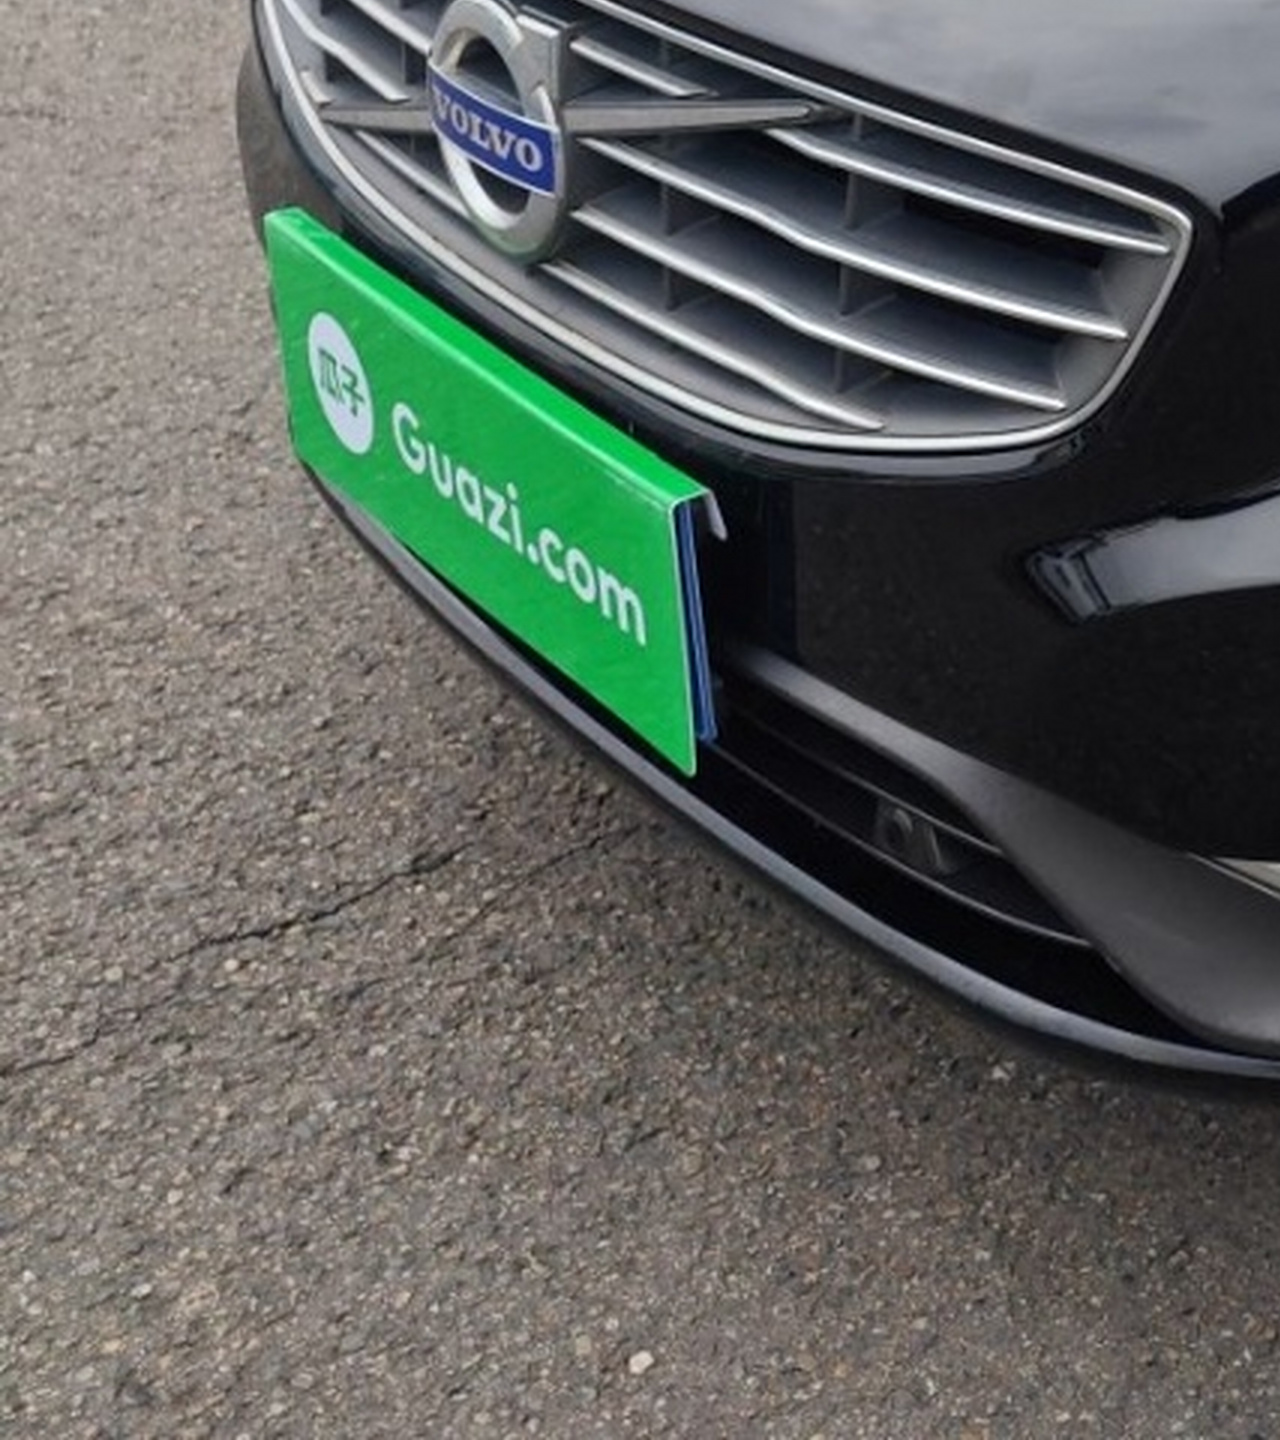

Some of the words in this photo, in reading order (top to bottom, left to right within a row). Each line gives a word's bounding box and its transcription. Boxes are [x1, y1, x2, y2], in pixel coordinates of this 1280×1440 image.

[430, 82, 545, 173] VOLVO
[317, 346, 366, 418] 瓜子
[391, 401, 647, 647] Guazi.com
